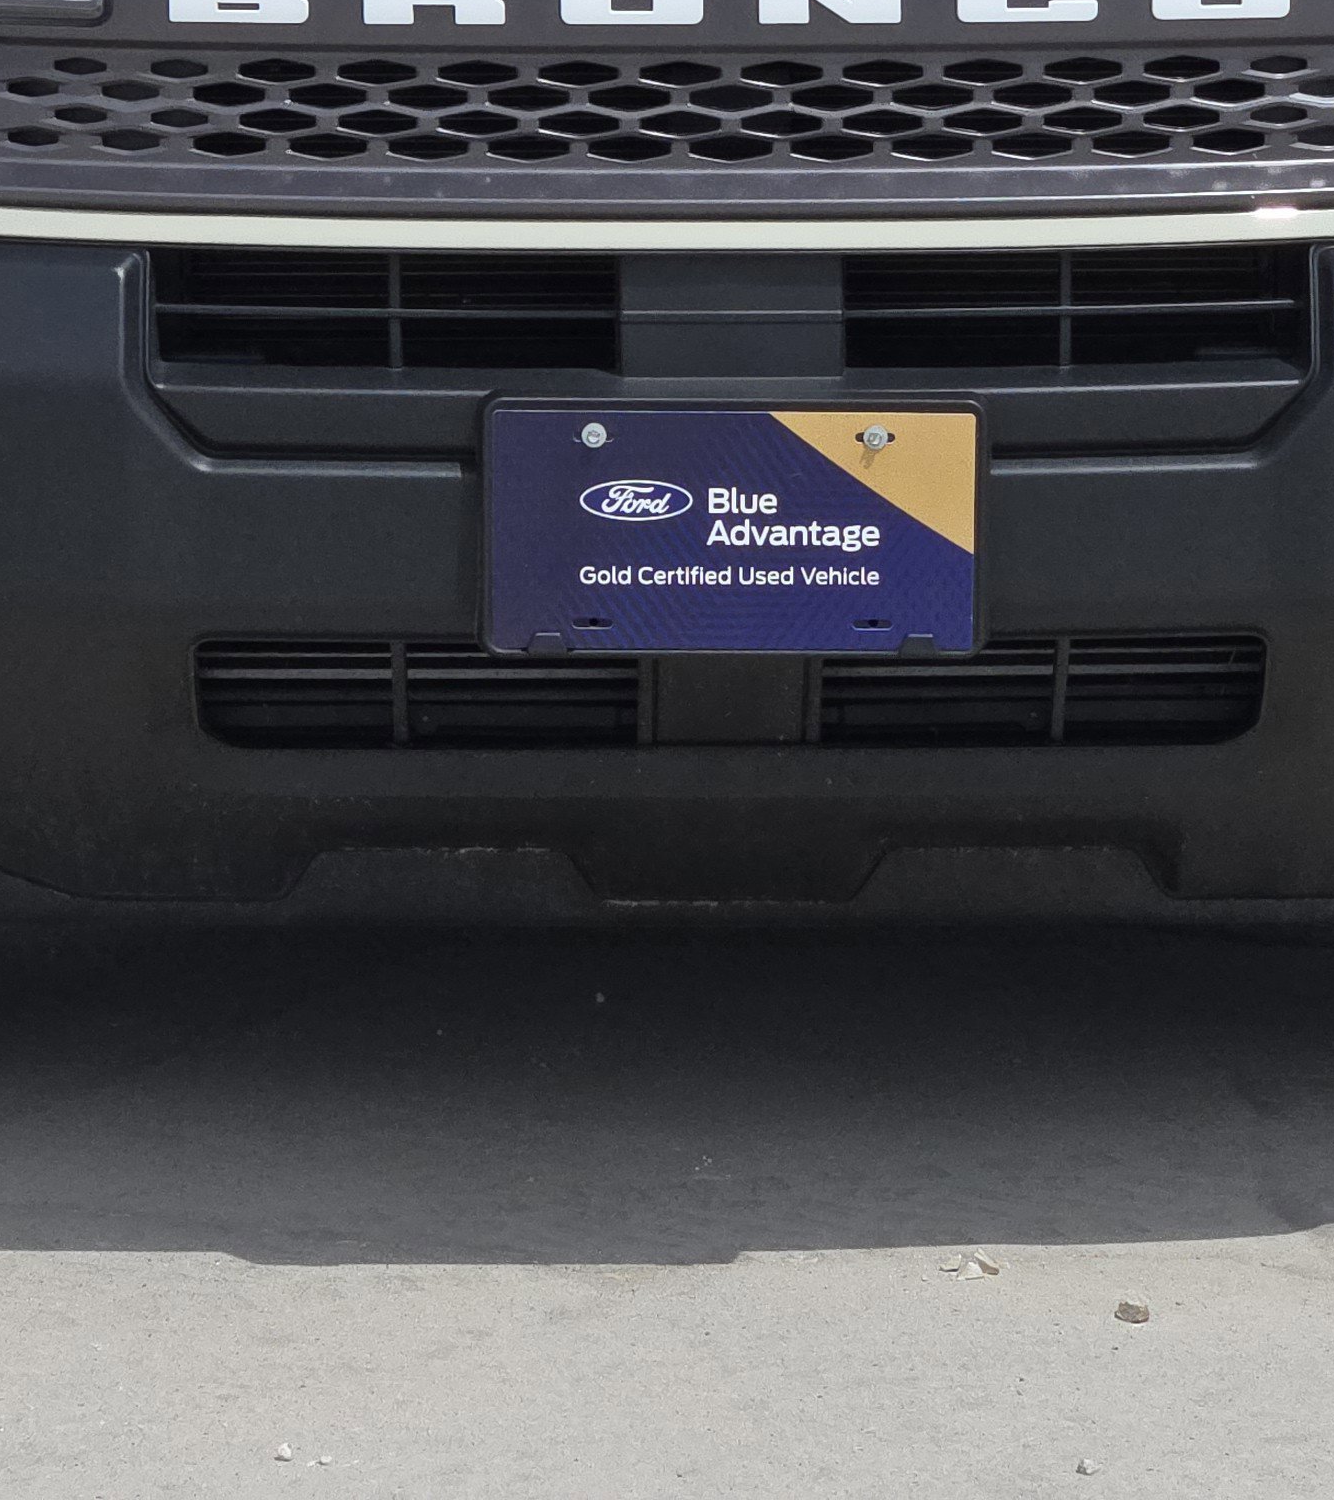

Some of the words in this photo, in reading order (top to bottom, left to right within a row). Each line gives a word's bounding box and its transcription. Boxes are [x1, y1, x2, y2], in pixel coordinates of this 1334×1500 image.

[600, 484, 672, 514] Ford
[707, 487, 778, 515] Blue
[706, 519, 881, 552] Advantage
[578, 565, 632, 586] Gold
[637, 565, 732, 586] Certified
[738, 566, 795, 586] Used
[800, 566, 881, 586] Vehicle
